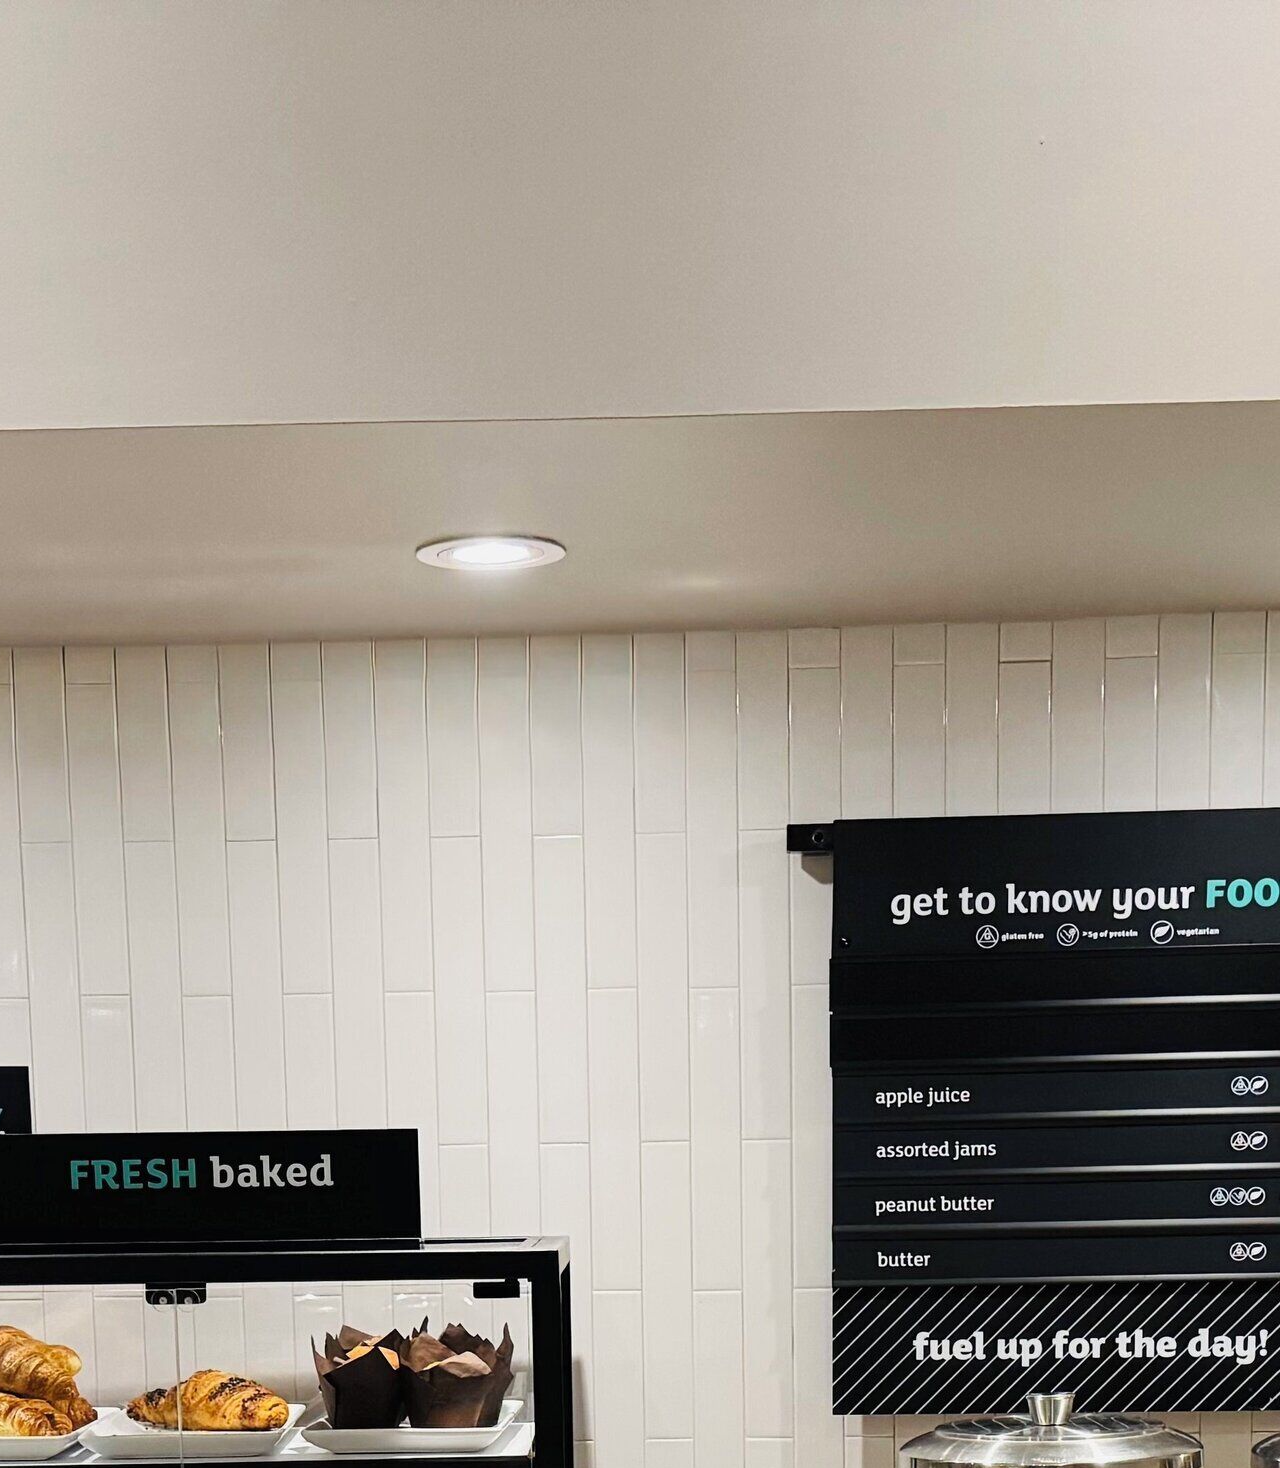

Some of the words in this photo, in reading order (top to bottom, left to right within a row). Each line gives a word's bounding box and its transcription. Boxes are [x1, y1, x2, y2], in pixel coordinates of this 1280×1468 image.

[891, 887, 947, 925] get
[960, 886, 995, 915] to
[1006, 883, 1101, 914] know
[1112, 884, 1195, 920] your
[1099, 929, 1108, 938] of
[1109, 929, 1138, 939] protein
[1176, 927, 1220, 937] vegetarian
[875, 1088, 924, 1108] apple
[926, 1087, 971, 1107] juice
[876, 1141, 950, 1158] assorted
[953, 1141, 997, 1160] jams
[70, 1158, 197, 1190] FRESH
[209, 1154, 334, 1188] baked
[875, 1197, 936, 1217] peanut
[940, 1196, 995, 1212] butter
[877, 1252, 931, 1268] butter
[912, 1331, 986, 1361] fuel
[996, 1338, 1044, 1368] up
[1052, 1330, 1106, 1359] for
[1115, 1329, 1177, 1359] the
[1187, 1328, 1269, 1365] day!
